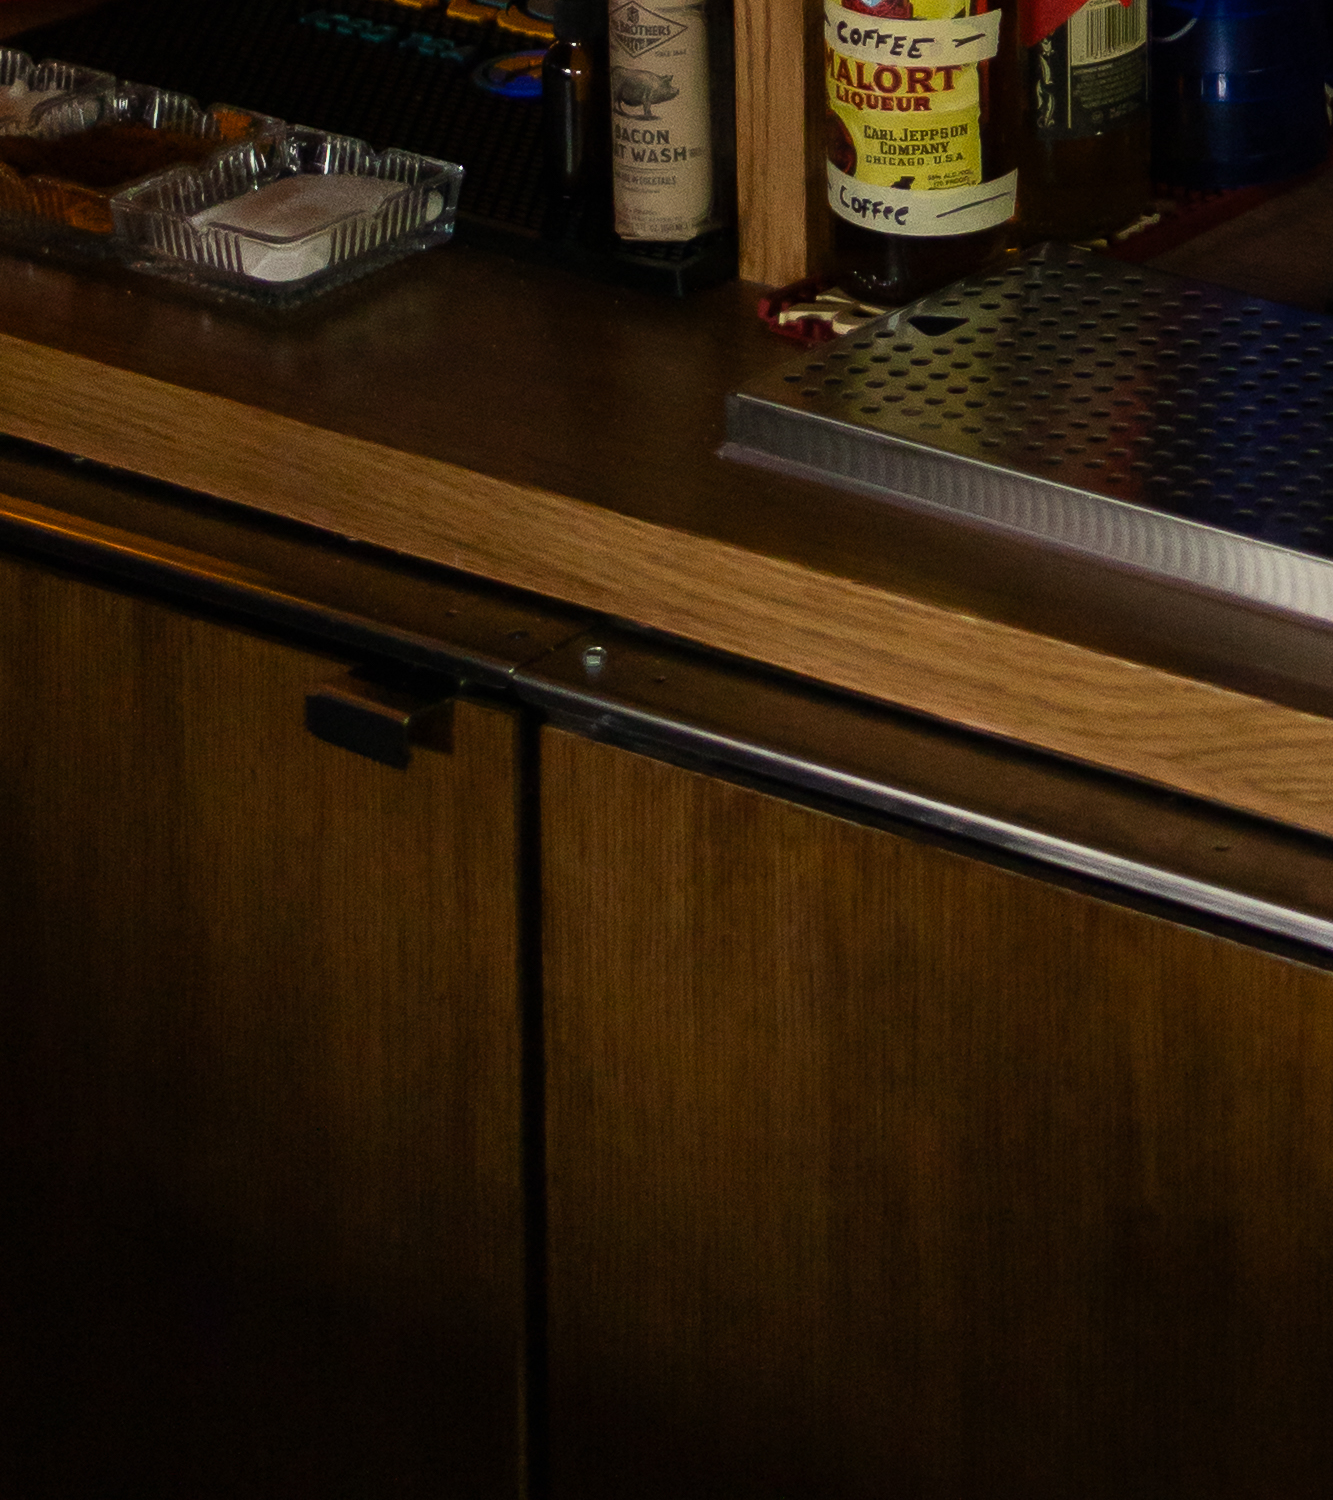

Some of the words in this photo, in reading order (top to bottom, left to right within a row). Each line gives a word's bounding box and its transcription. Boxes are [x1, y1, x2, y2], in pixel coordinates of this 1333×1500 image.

[836, 20, 936, 59] COFFEE
[836, 86, 931, 112] LIQUEUR
[864, 125, 898, 143] CARL
[901, 124, 969, 142] JEPPSON
[632, 146, 688, 164] WASH
[879, 140, 950, 157] COMPANY
